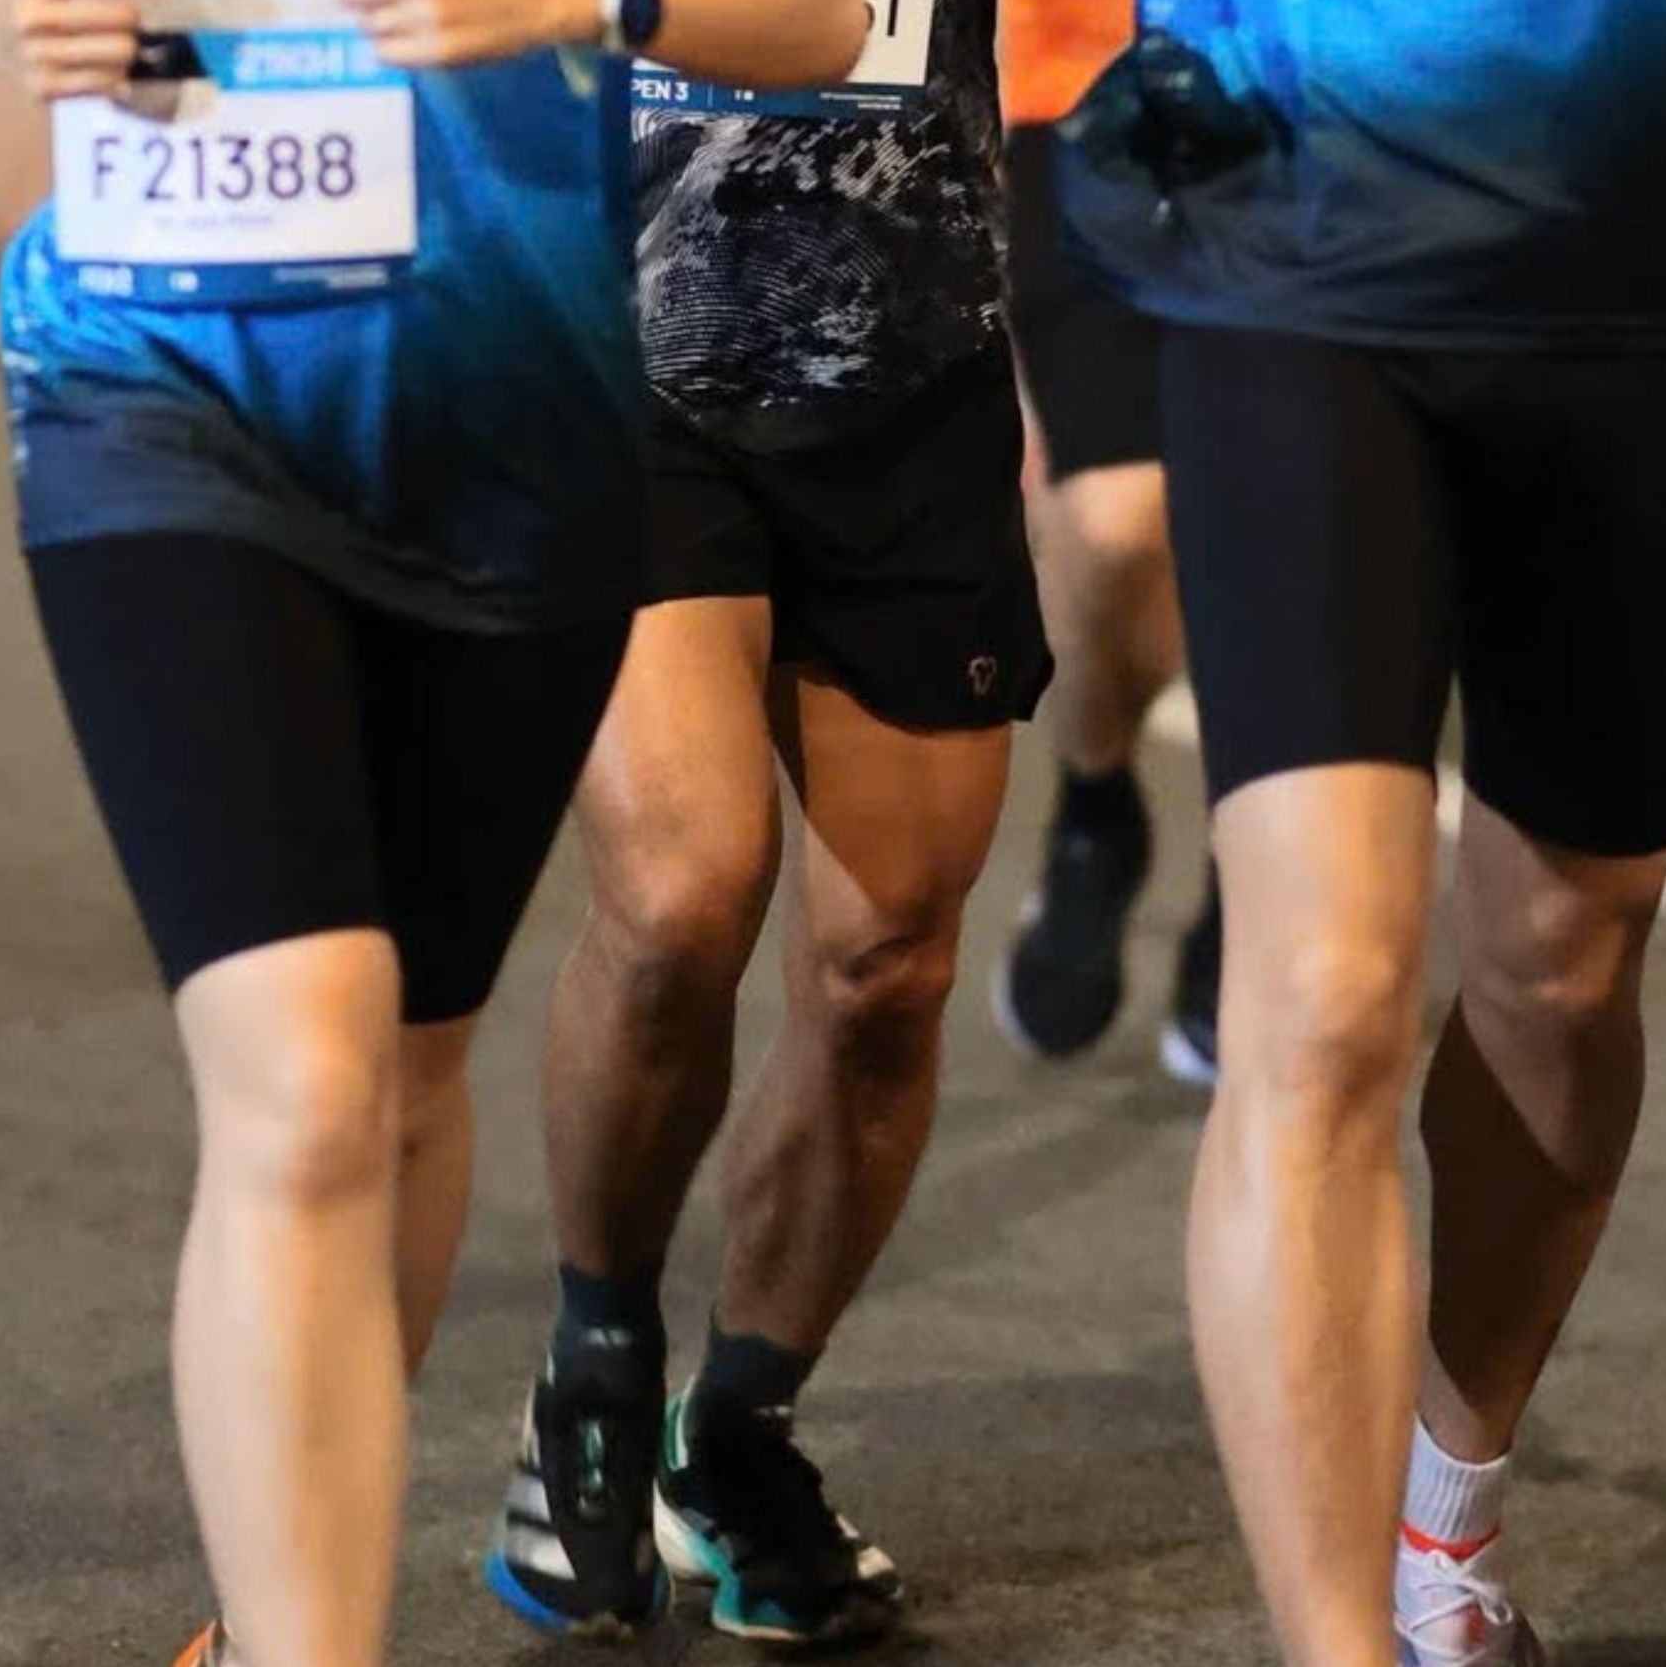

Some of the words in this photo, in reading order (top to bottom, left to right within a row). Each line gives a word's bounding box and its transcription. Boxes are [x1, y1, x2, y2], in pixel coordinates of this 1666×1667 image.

[675, 82, 688, 101] 3
[93, 135, 121, 200] F
[141, 133, 356, 201] 21388
